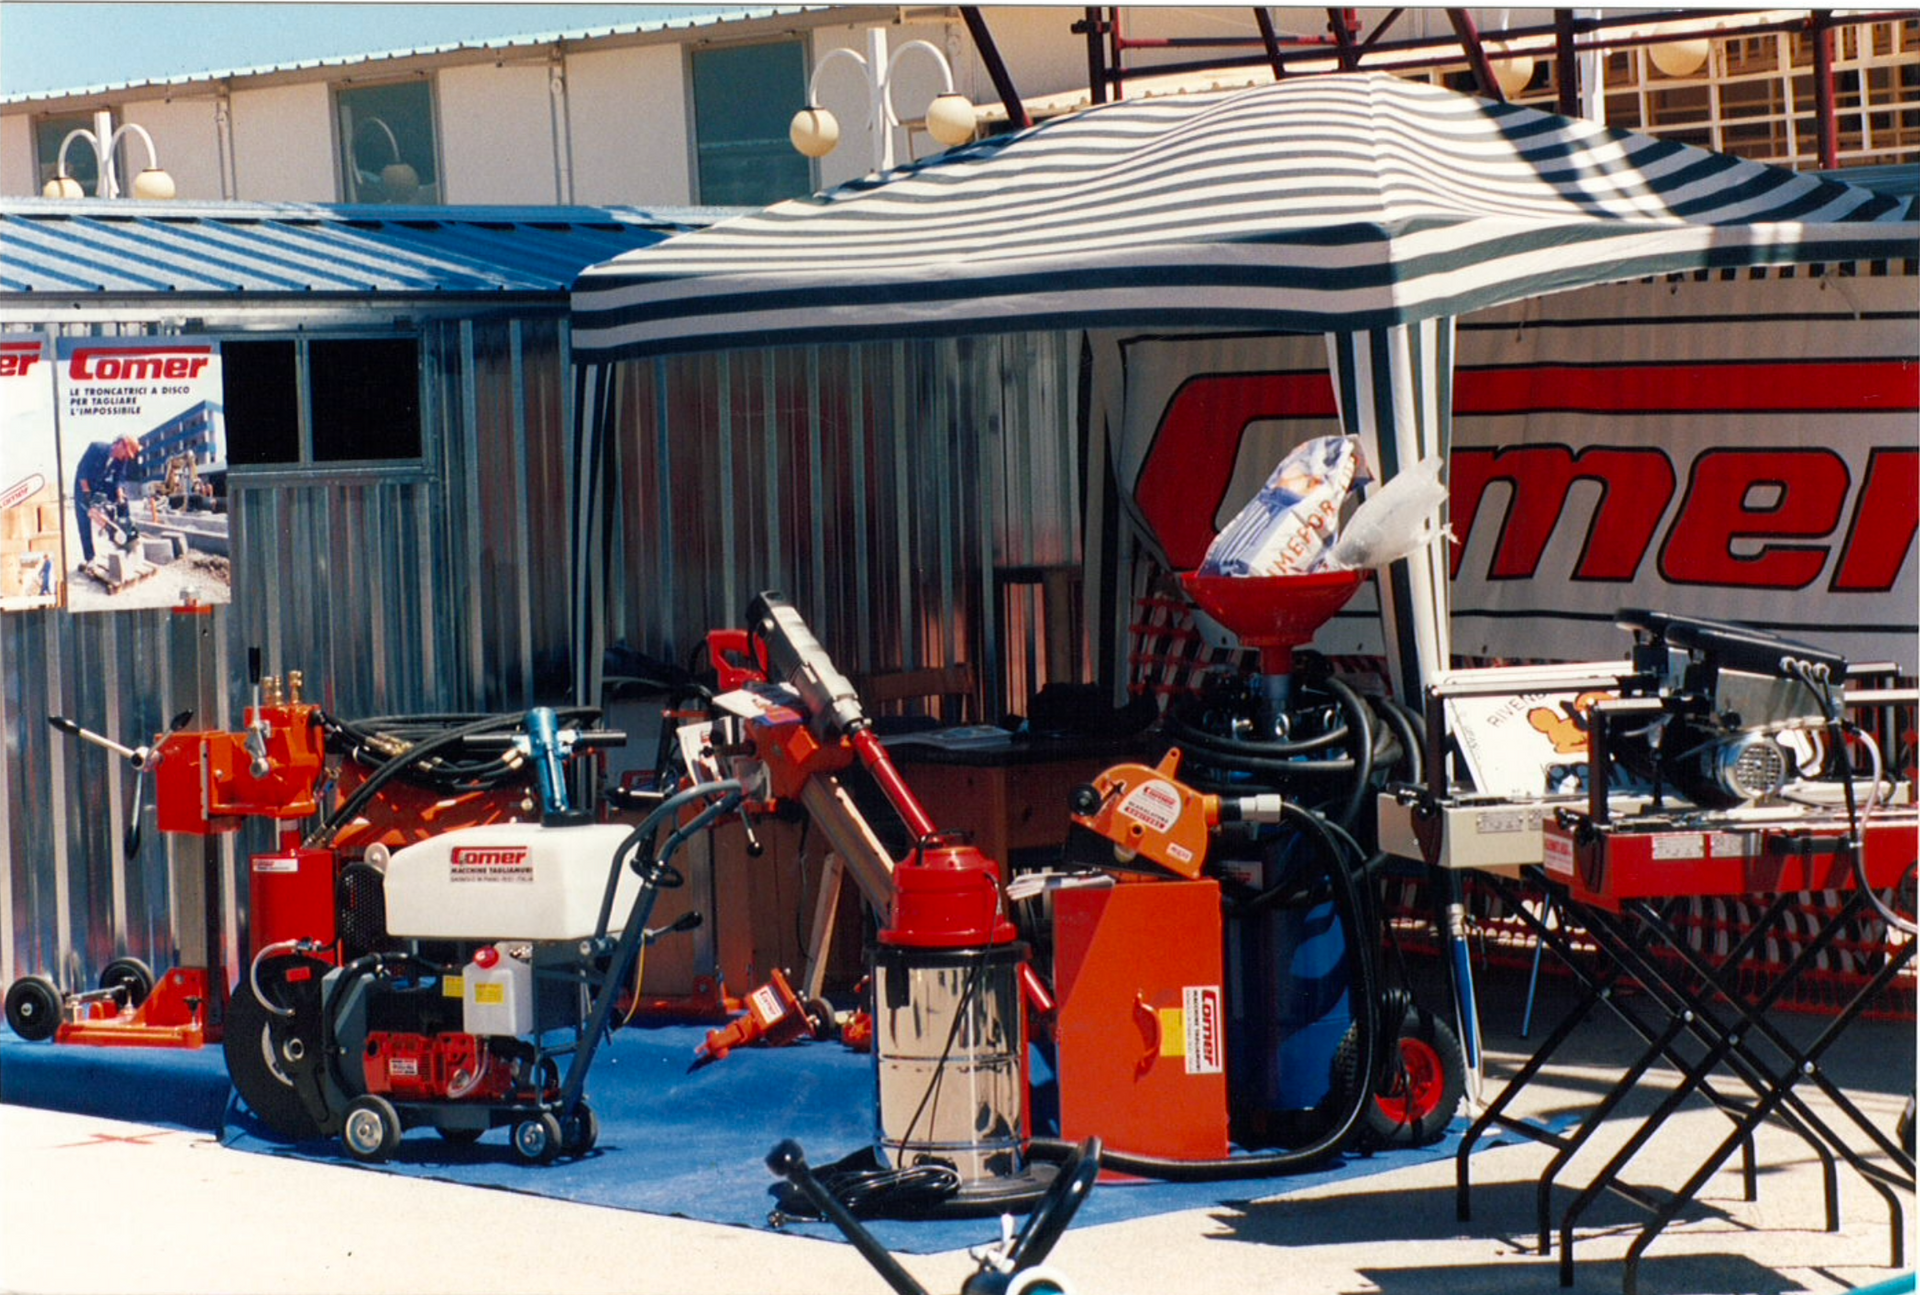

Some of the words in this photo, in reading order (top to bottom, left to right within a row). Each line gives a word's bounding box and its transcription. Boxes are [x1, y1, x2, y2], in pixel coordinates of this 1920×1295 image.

[69, 345, 211, 379] Comer
[69, 388, 79, 396] LE
[84, 387, 147, 395] TRONCATRICI
[151, 386, 158, 394] A
[161, 386, 190, 394] DISCO
[70, 398, 88, 406] PER
[92, 397, 137, 405] TAGLIARE
[70, 406, 141, 416] L'IMPOSSIBILE
[1131, 357, 1919, 593] Cmer
[450, 846, 528, 865] Comer
[1202, 989, 1219, 1067] Comer
